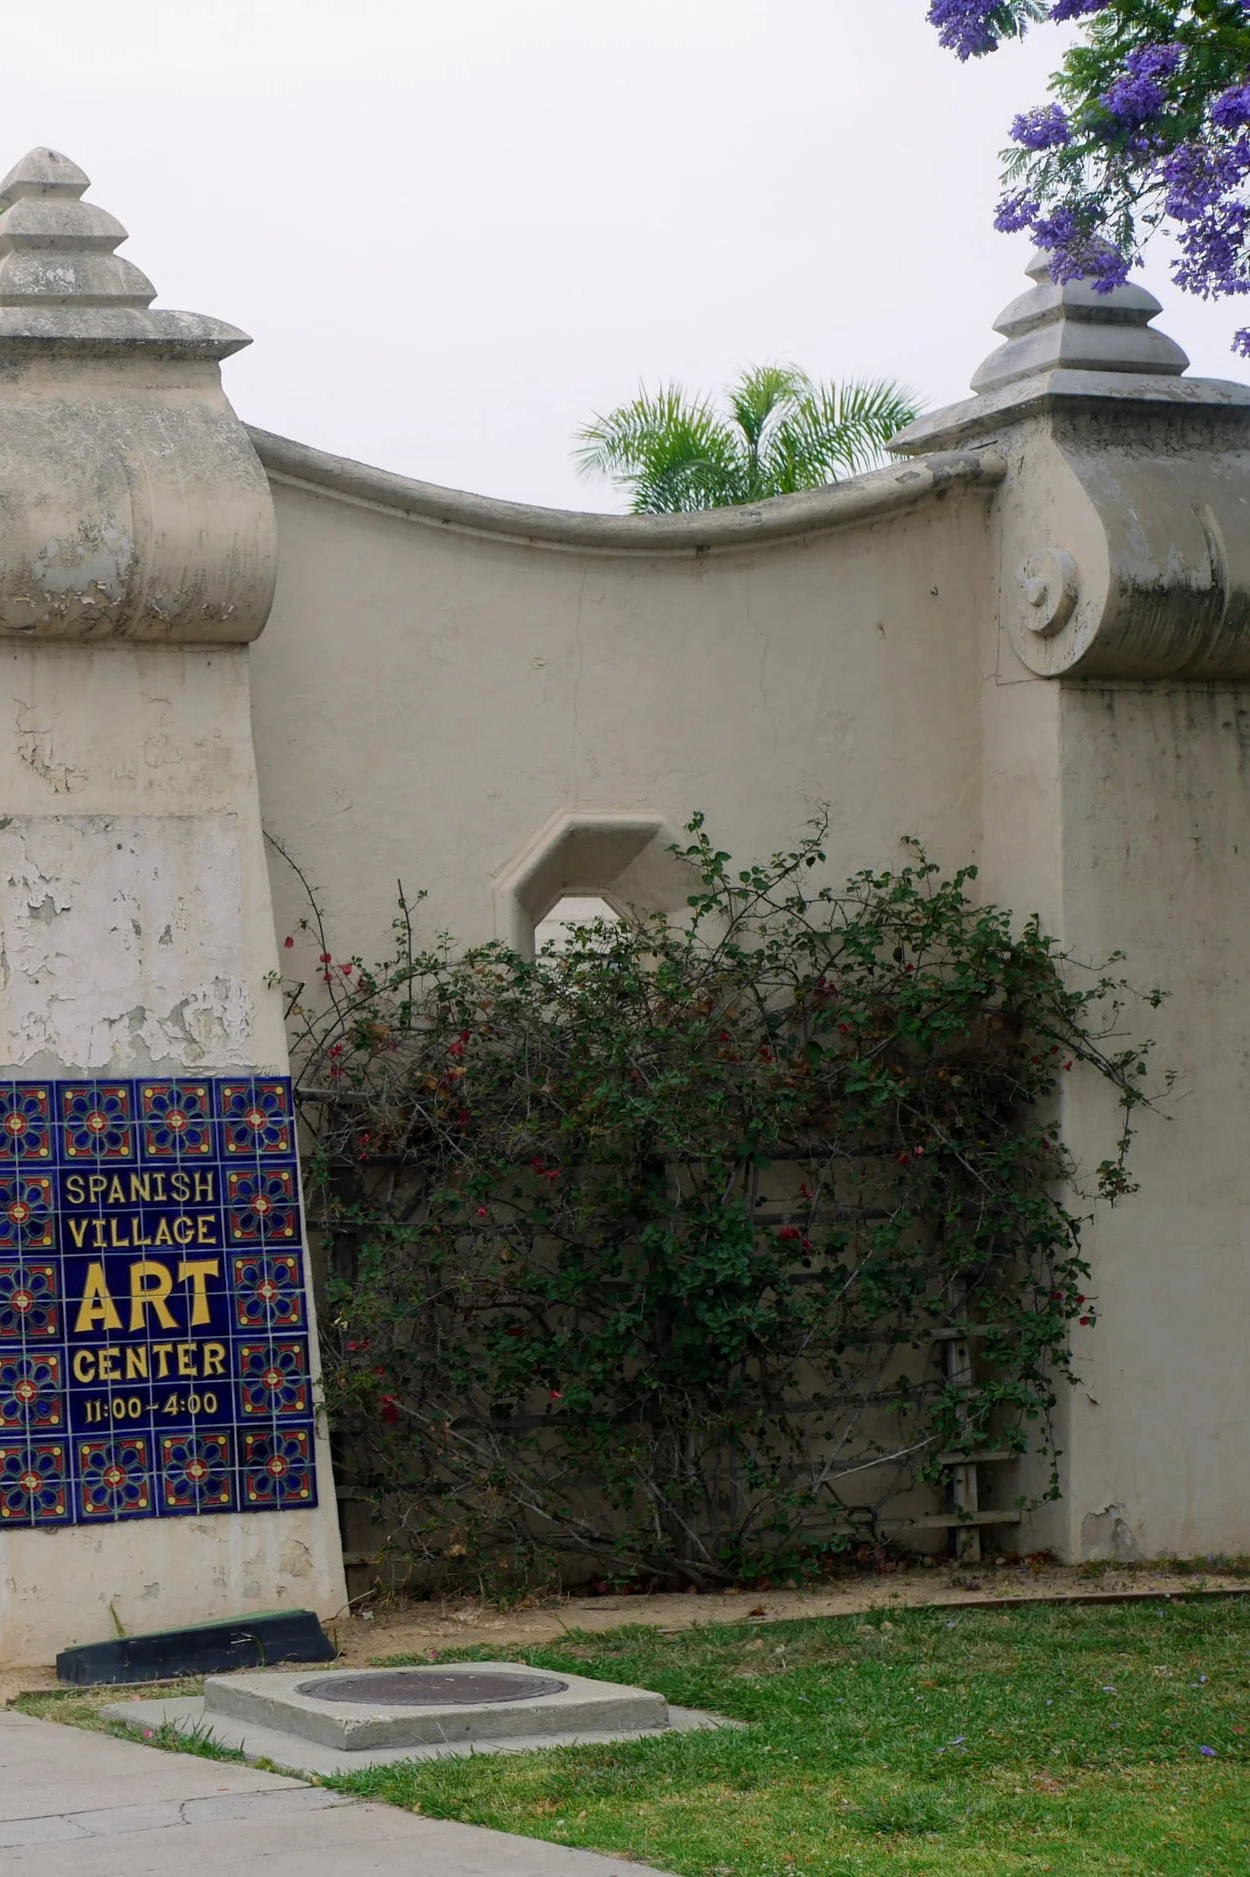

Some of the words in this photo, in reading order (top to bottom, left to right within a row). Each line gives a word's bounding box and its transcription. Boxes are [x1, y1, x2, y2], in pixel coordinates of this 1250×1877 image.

[66, 1171, 214, 1204] SPANISH
[67, 1214, 217, 1248] VILLAGE
[74, 1258, 220, 1333] ART
[73, 1341, 227, 1383] CENTER
[85, 1392, 218, 1424] 11:00-4:00
